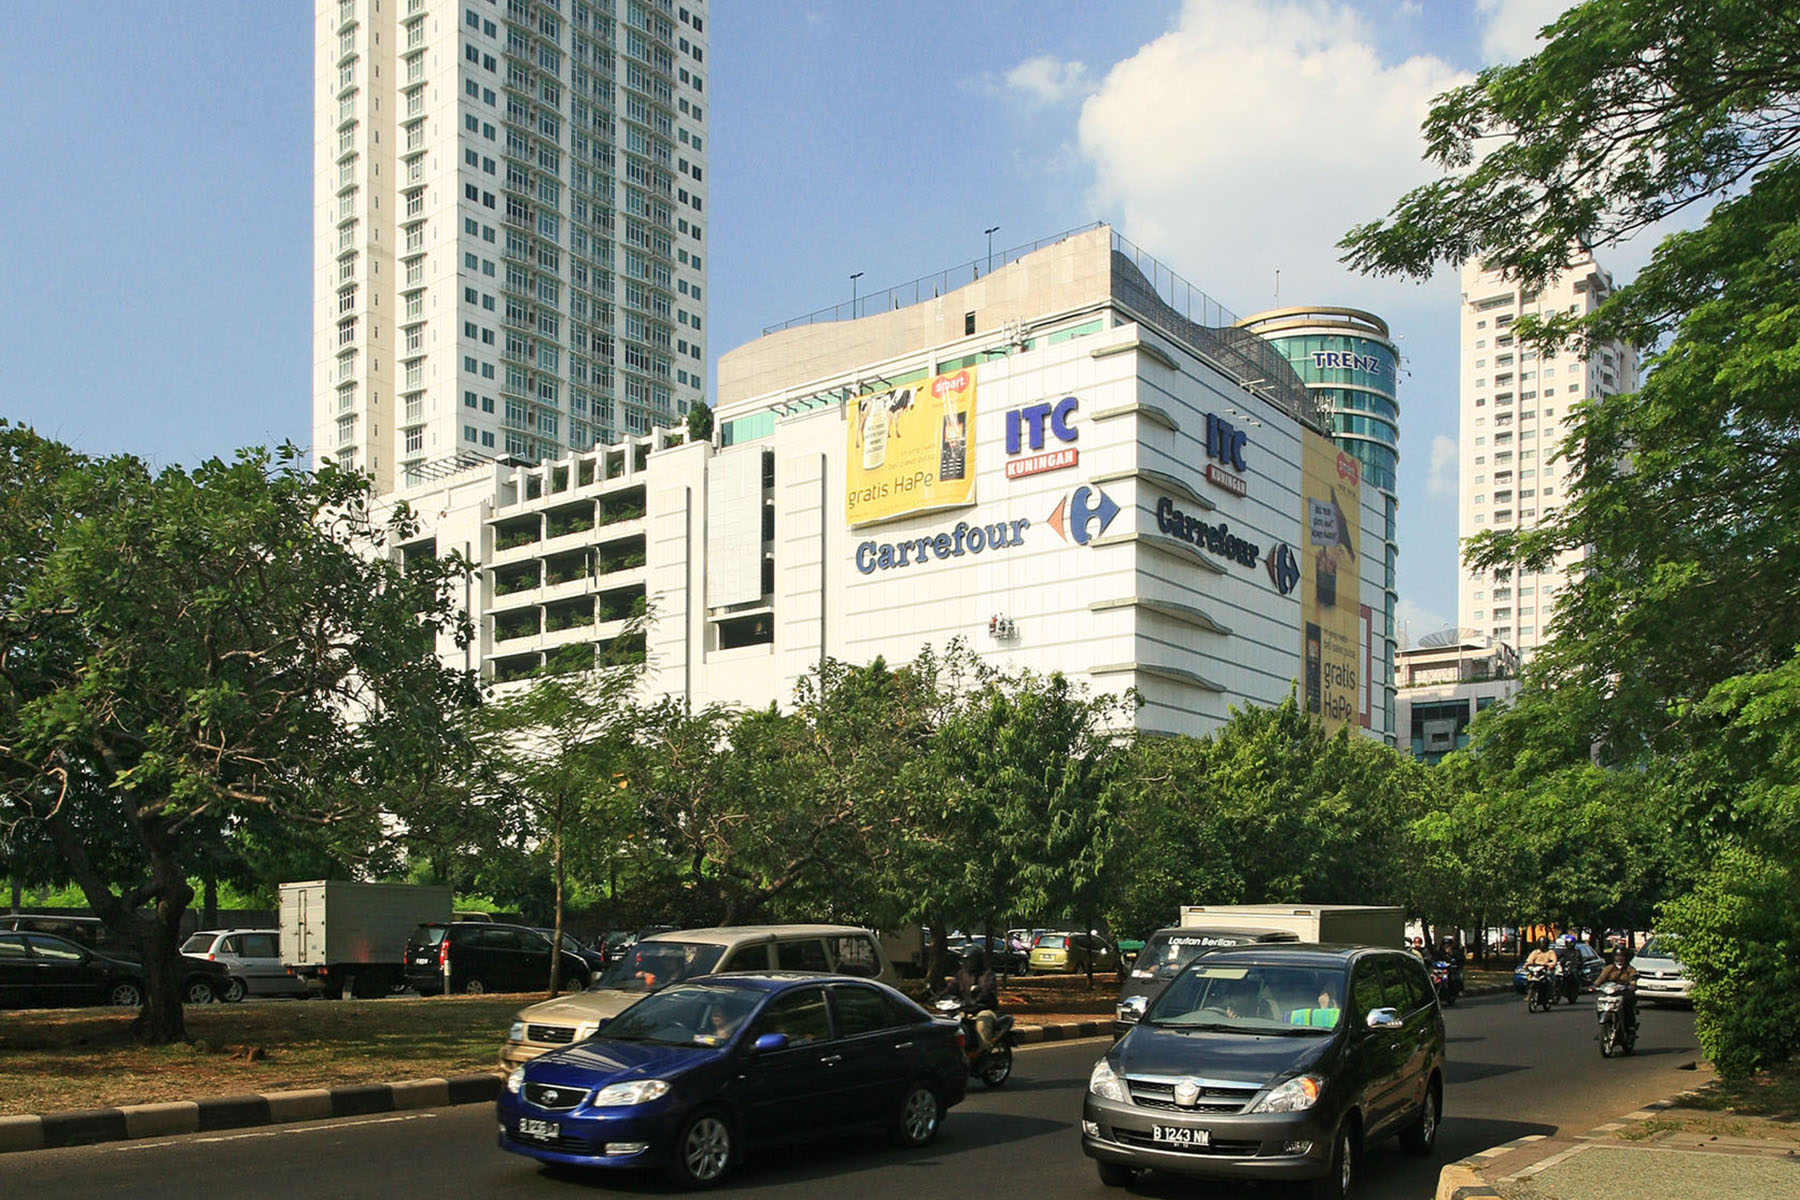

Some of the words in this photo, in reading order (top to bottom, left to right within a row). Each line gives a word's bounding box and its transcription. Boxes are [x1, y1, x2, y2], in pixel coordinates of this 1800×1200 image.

[1311, 350, 1380, 375] TRENZ
[1006, 396, 1078, 454] ITC
[1207, 412, 1247, 472] ITC
[1007, 450, 1074, 476] KUNINGAN
[848, 482, 889, 510] gratis
[894, 471, 934, 495] HaPe
[856, 517, 1031, 574] Carrefour
[1157, 496, 1260, 569] Carrefour
[1324, 662, 1356, 690] gratis
[1324, 690, 1352, 722] HaPe
[1168, 936, 1201, 945] Lautan
[1201, 937, 1237, 947] Berlian
[1153, 1126, 1161, 1140] B
[1165, 1127, 1191, 1142] 1243
